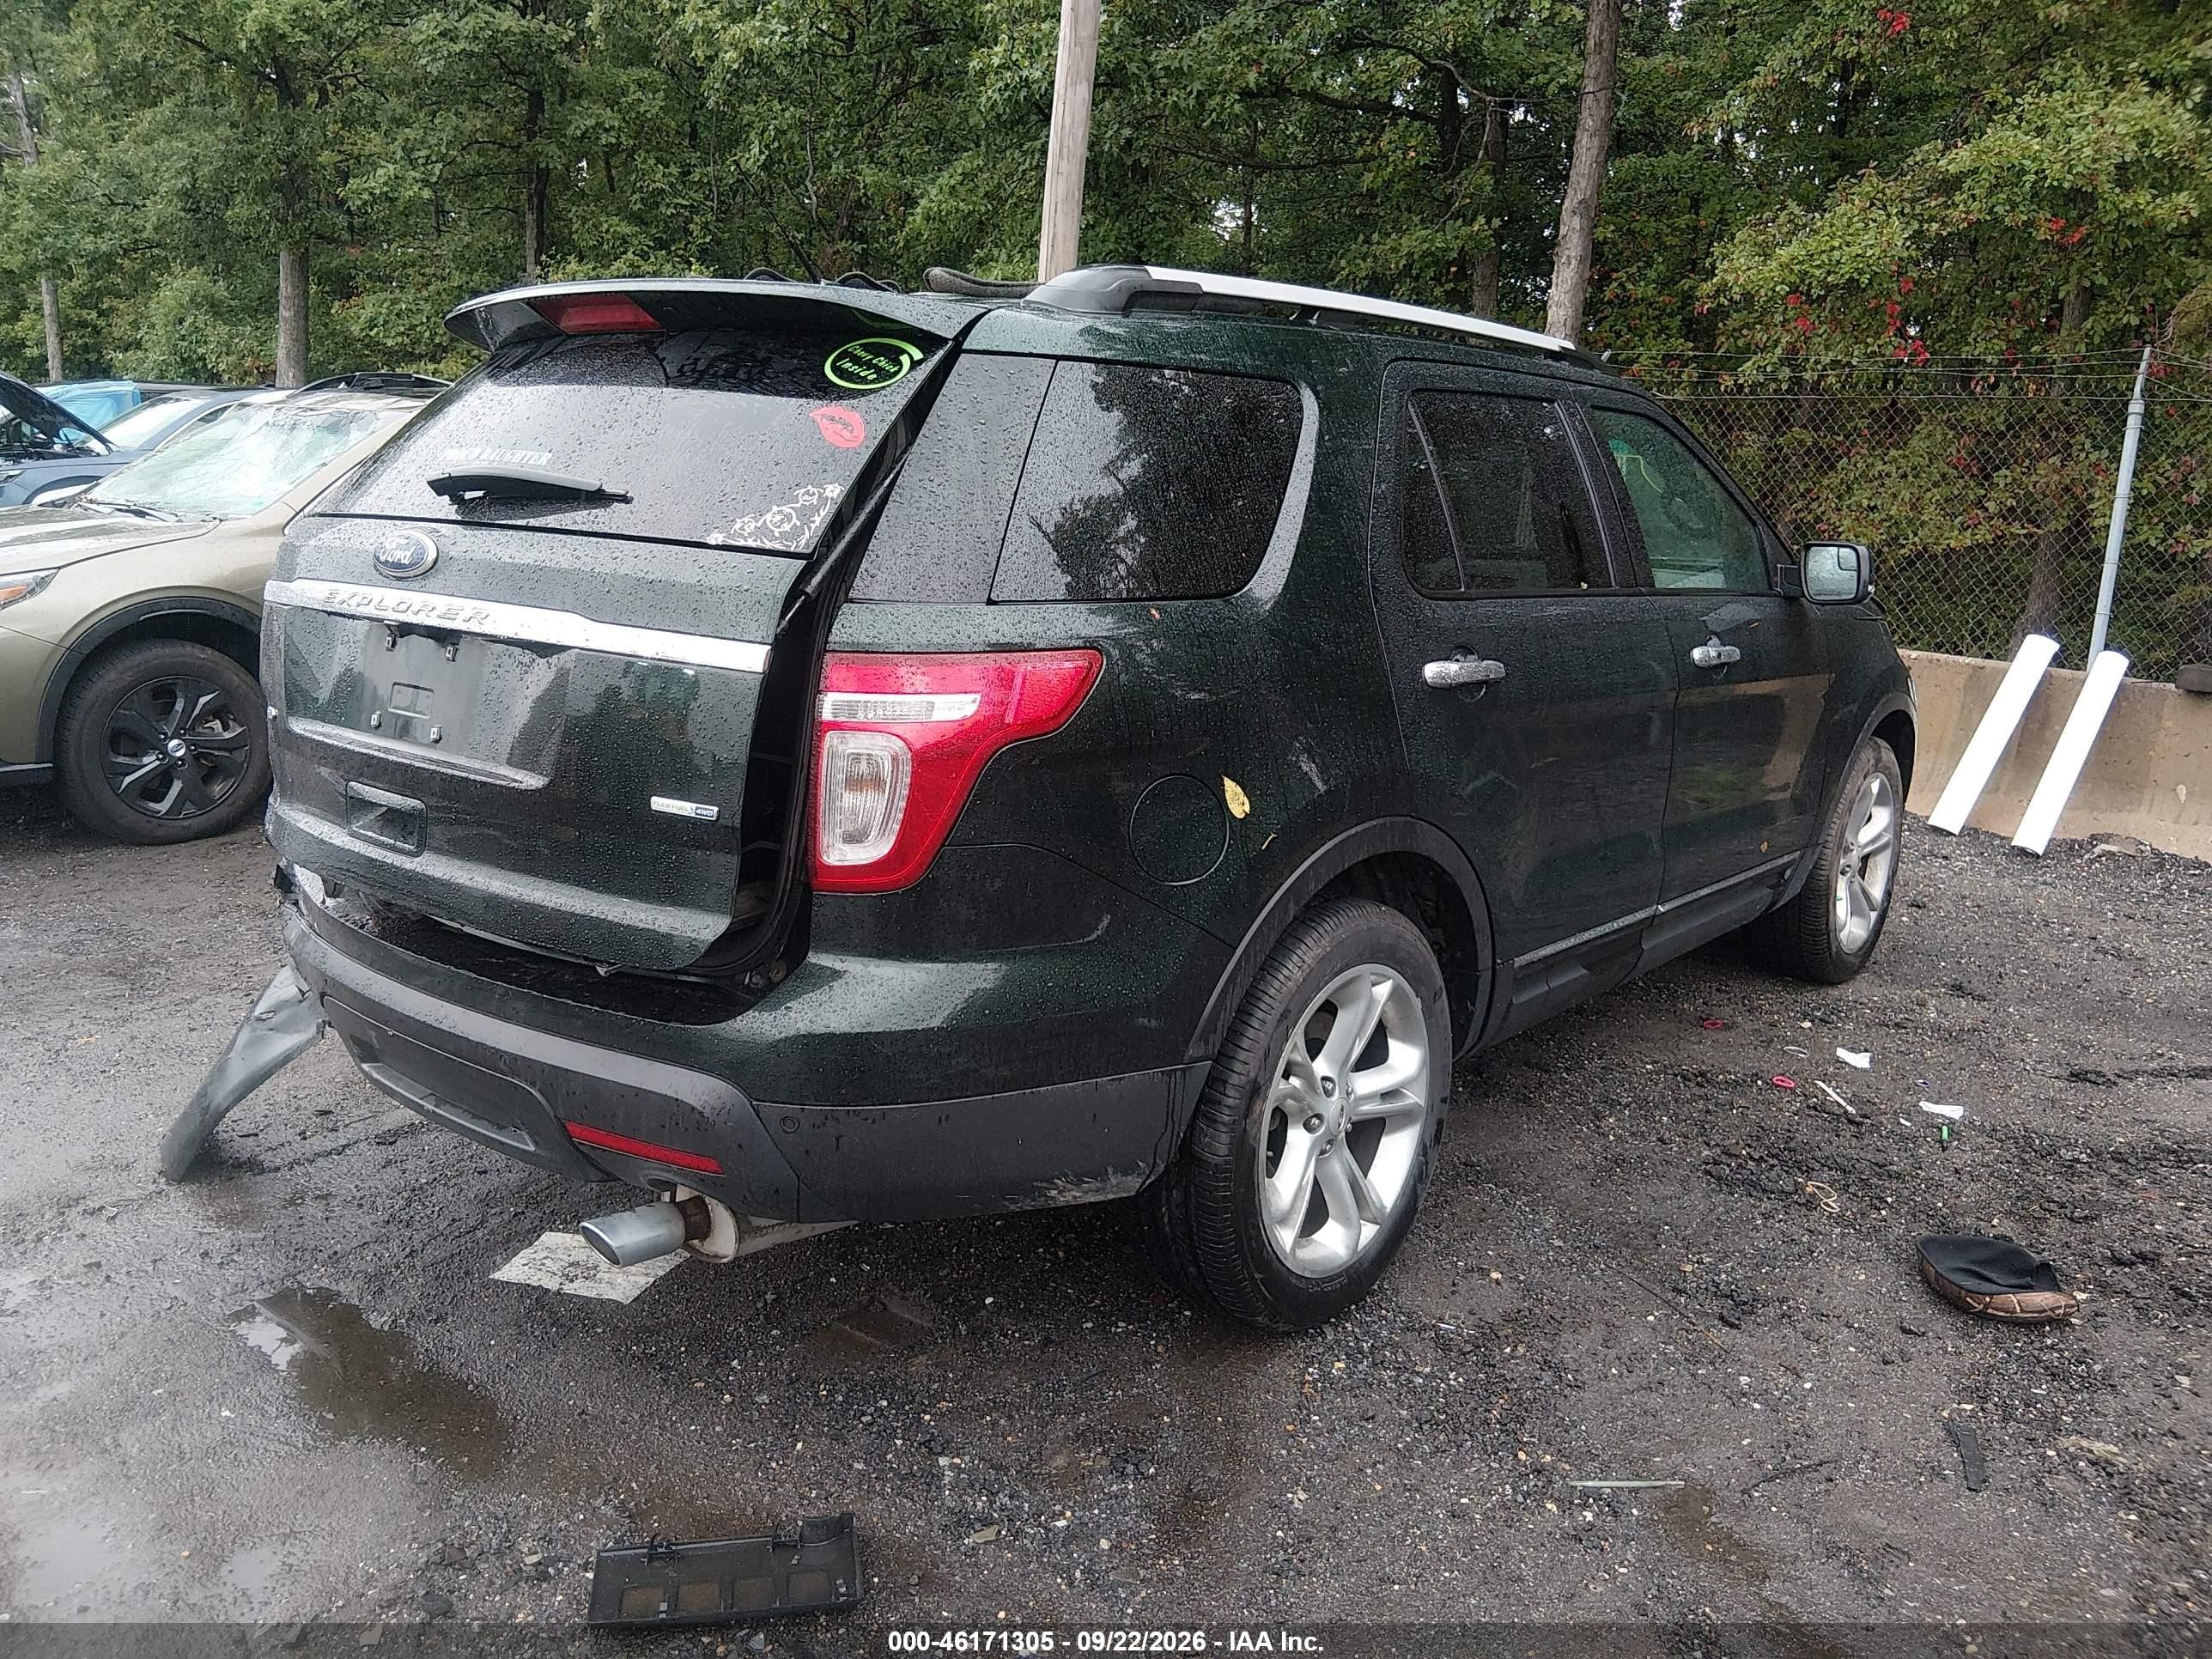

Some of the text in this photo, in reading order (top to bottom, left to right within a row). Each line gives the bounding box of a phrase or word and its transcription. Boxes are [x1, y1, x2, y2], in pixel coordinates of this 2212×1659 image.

[836, 358, 878, 380] Inside
[872, 356, 900, 373] Chick
[380, 536, 416, 565] Ford
[323, 589, 491, 625] EXPLORER
[653, 800, 714, 817] FLEX FUEL 4WD
